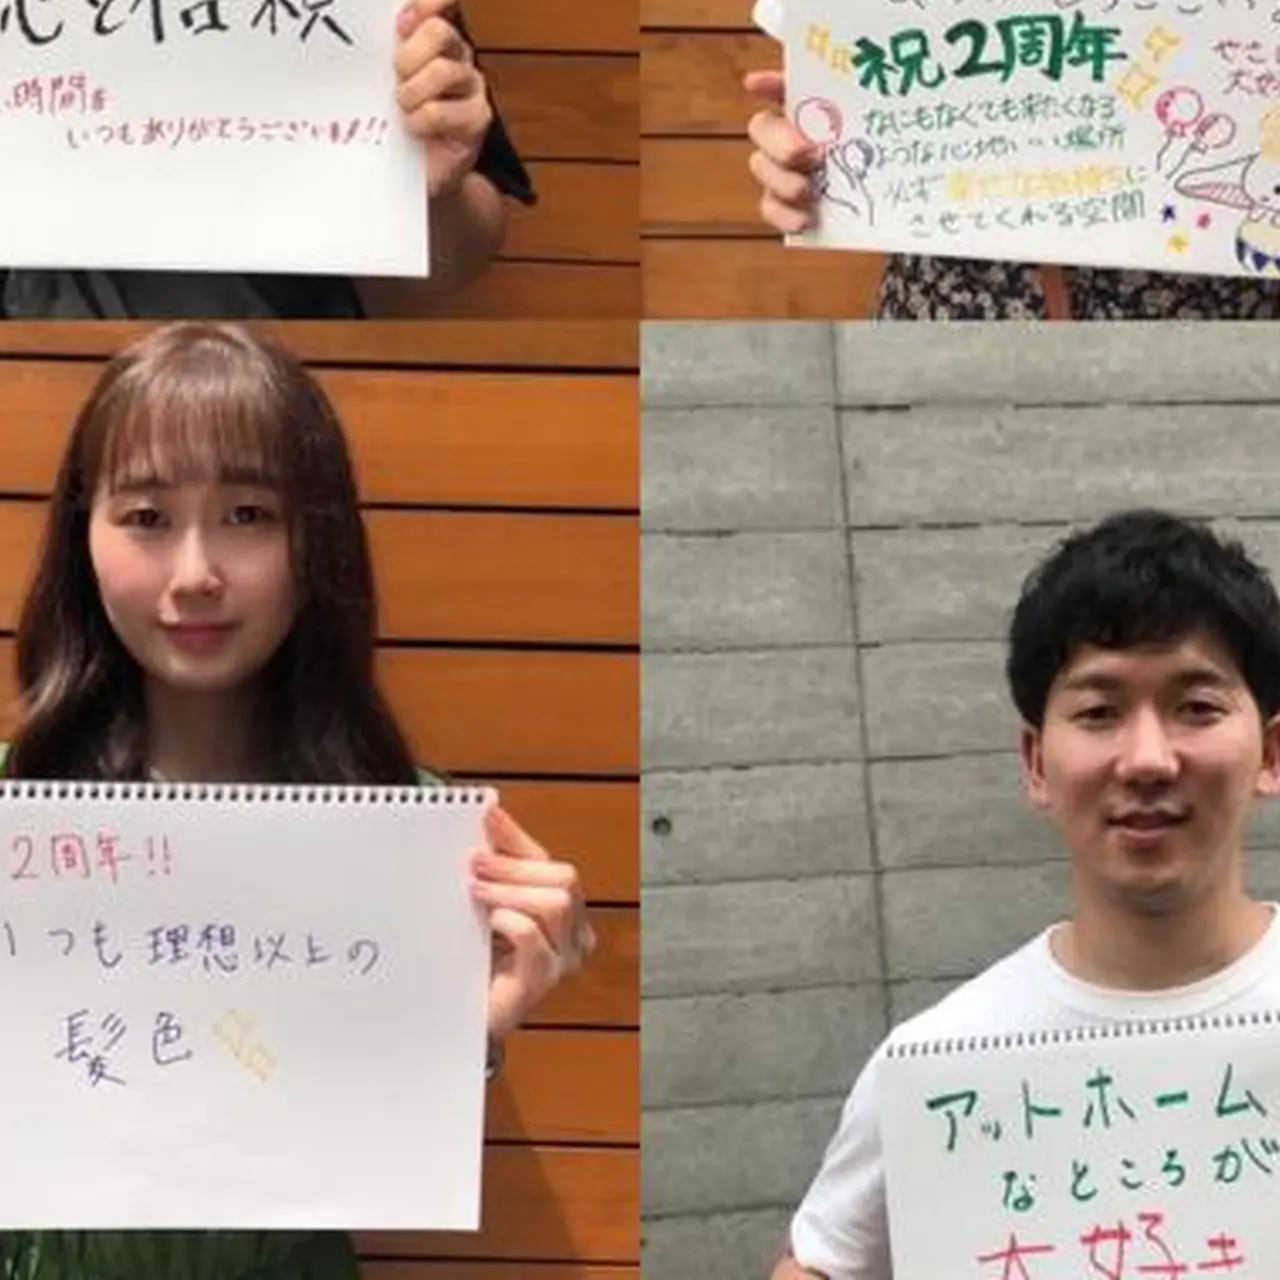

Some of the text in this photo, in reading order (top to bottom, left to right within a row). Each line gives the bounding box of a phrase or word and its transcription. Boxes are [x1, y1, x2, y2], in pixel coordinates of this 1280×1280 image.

[851, 10, 1128, 97] 祝2周年
[54, 1009, 195, 1088] 髪色
[925, 1062, 1269, 1153] アットホーム
